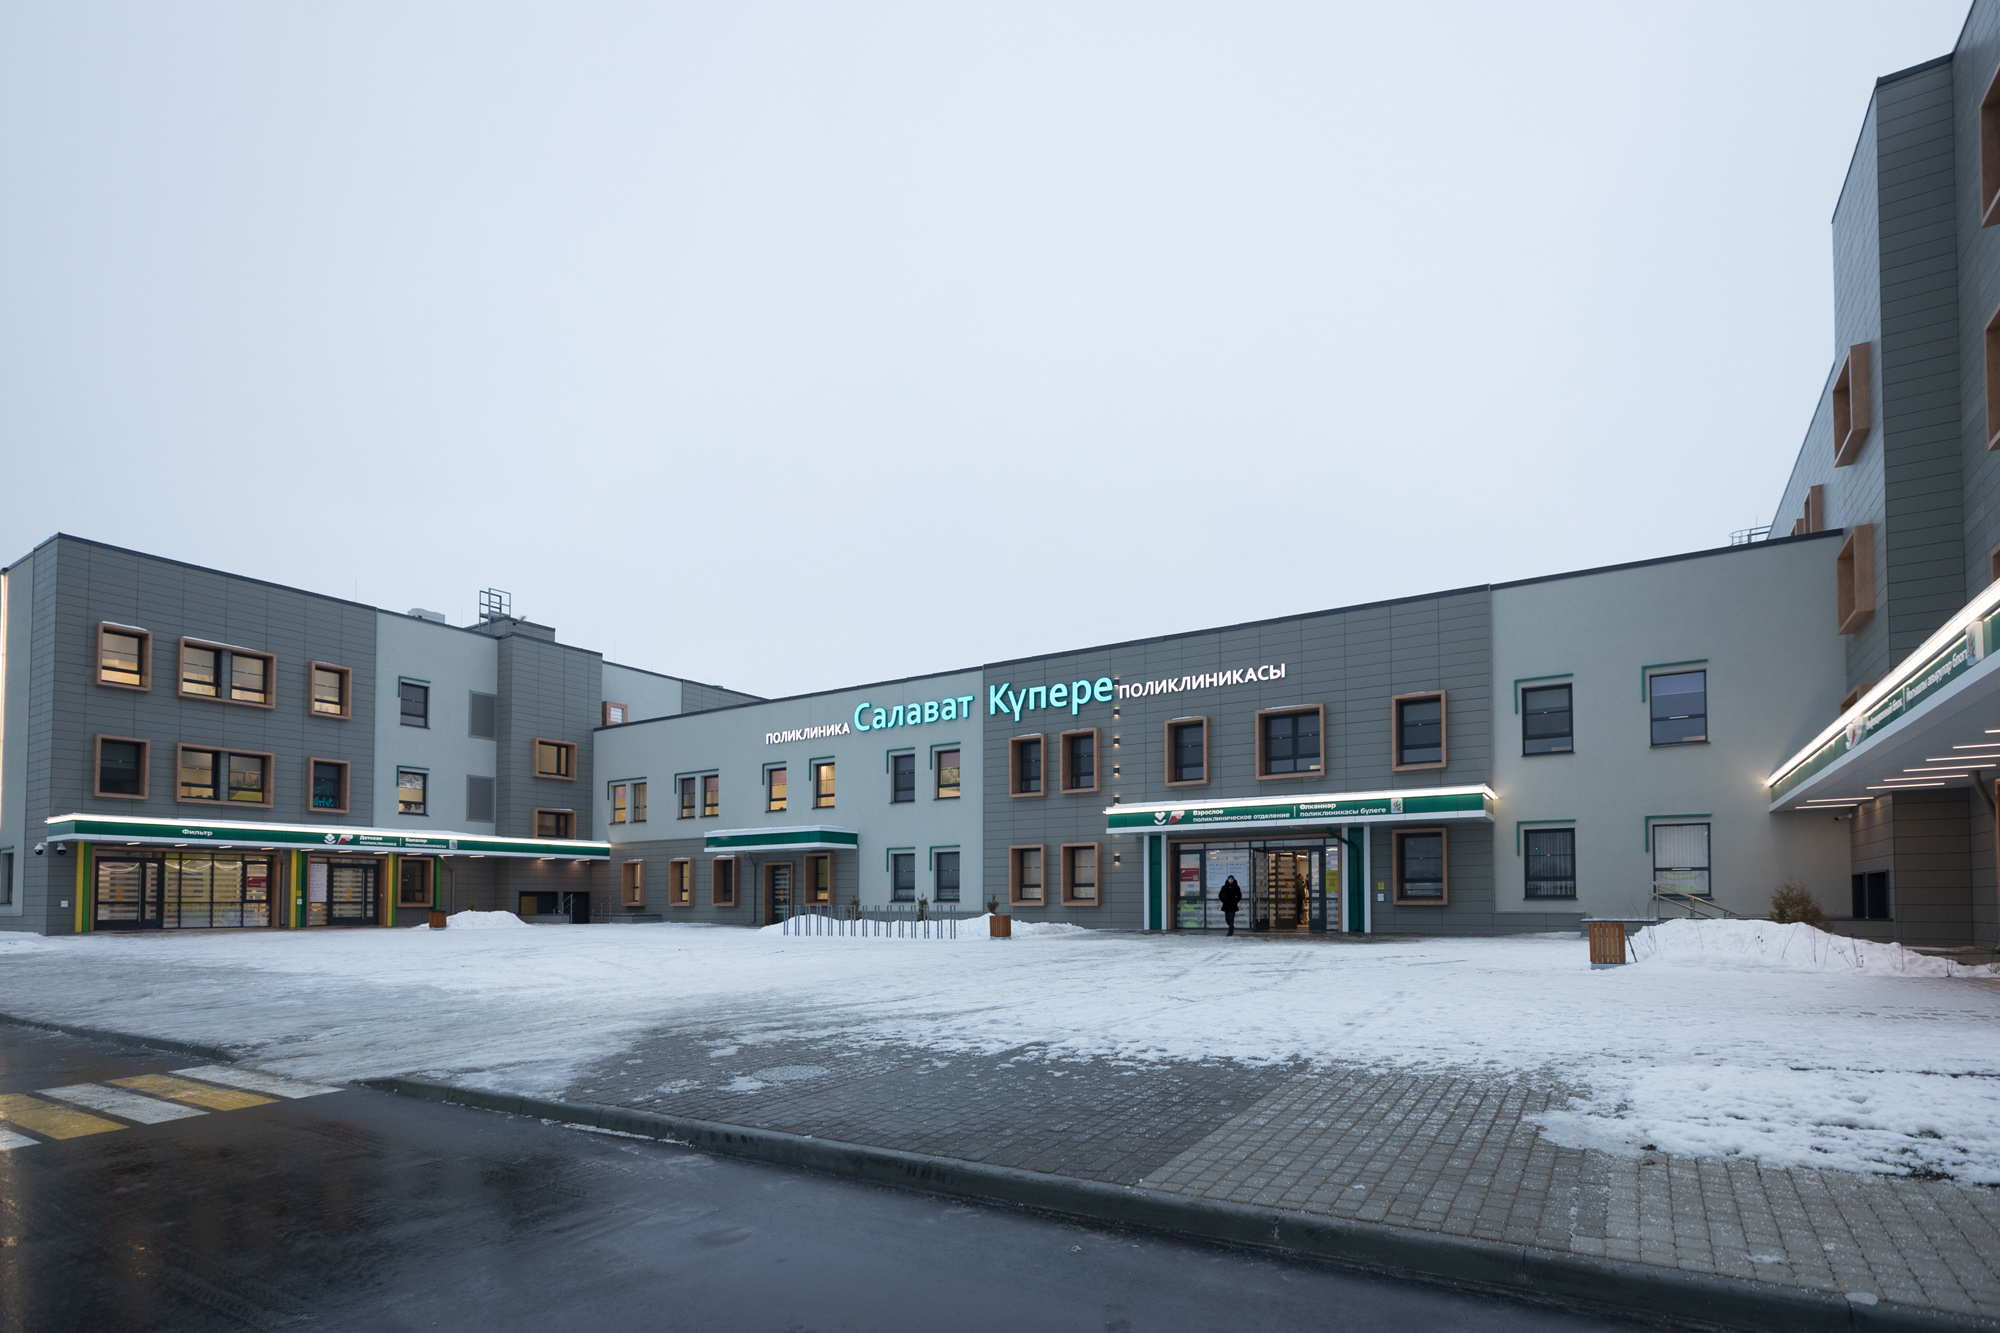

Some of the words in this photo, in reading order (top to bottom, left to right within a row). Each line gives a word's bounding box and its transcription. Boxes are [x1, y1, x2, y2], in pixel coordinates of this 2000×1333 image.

[1952, 649, 1968, 668] блог
[765, 722, 850, 744] ПОЛИКЛИНИКА
[853, 694, 974, 732] Салават
[989, 676, 1114, 722] Күпере
[1119, 663, 1286, 699] ПОЛИКЛИНИКАСЫ
[1299, 803, 1337, 811] Өлкәннәр
[1299, 809, 1359, 817] поликлиникасы
[1360, 807, 1386, 815] бүлеге
[1192, 815, 1252, 823] поликлиническое
[1253, 812, 1291, 820] отделение
[181, 828, 213, 837] Фильтр
